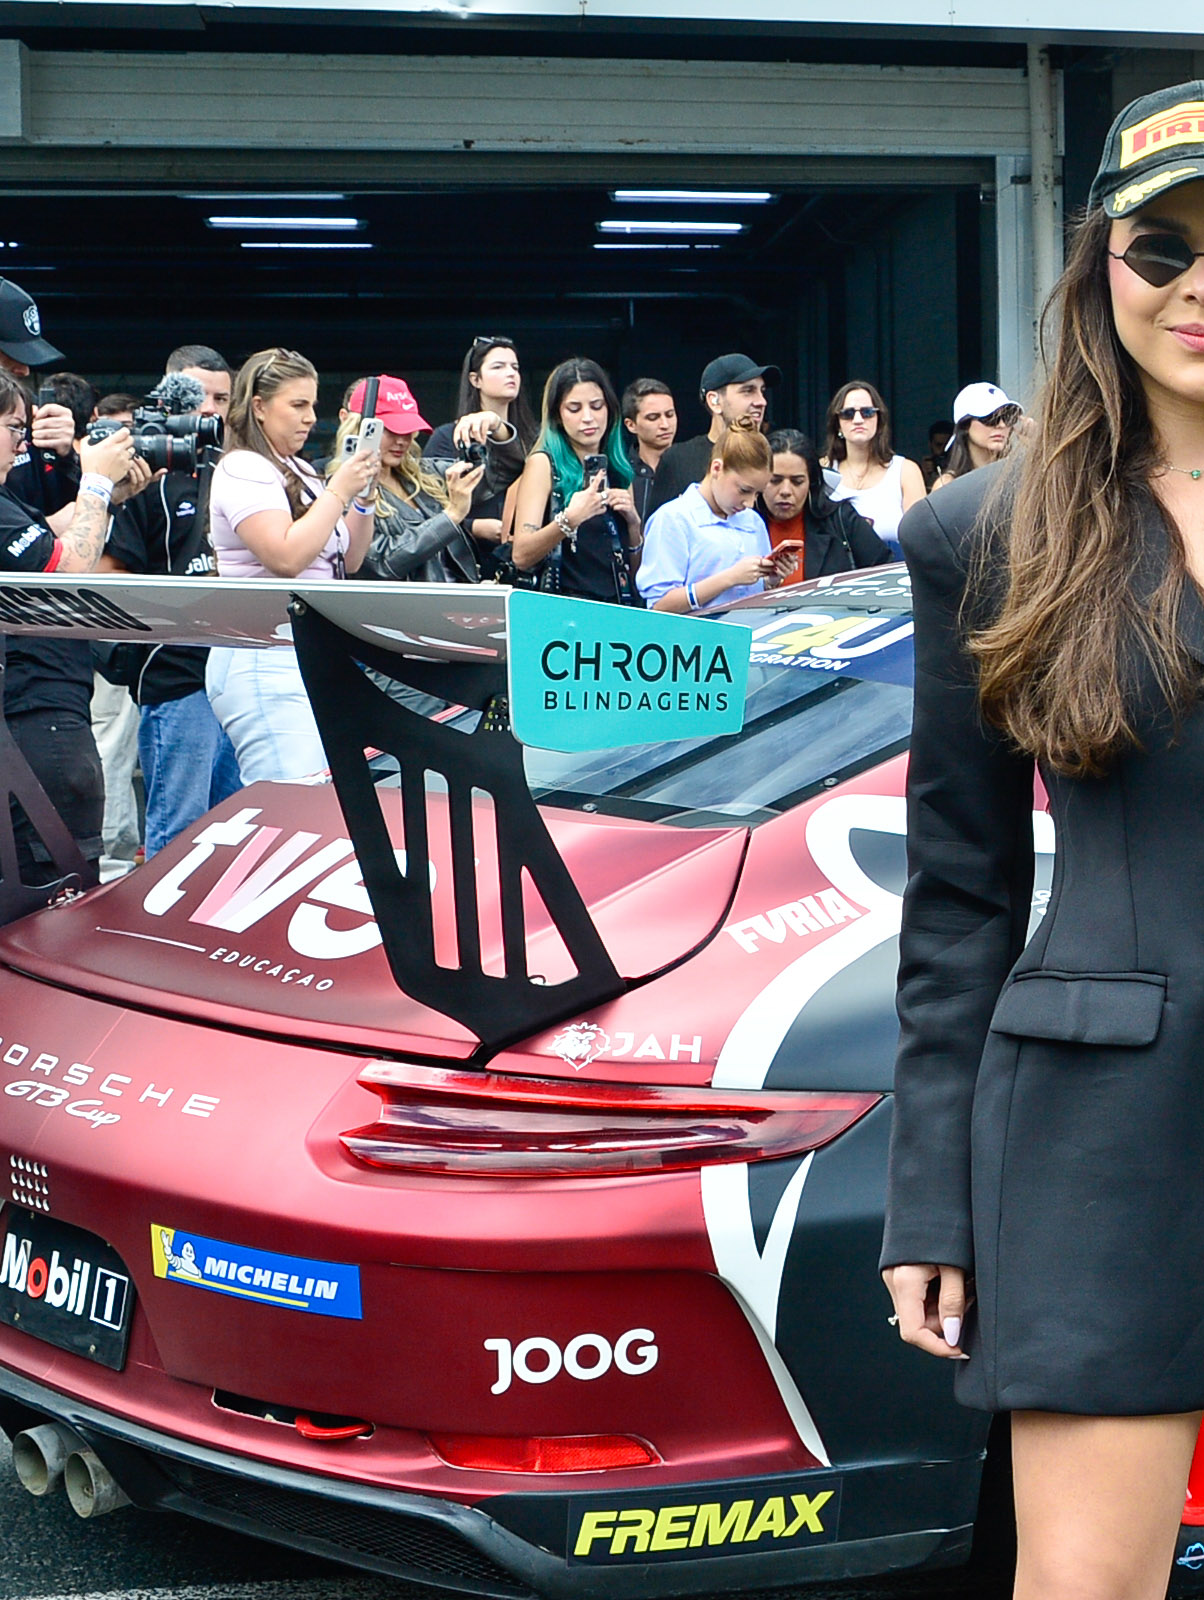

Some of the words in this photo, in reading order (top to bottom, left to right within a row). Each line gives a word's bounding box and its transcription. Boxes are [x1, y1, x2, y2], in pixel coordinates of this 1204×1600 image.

[12, 452, 31, 467] EDIA
[0, 586, 152, 632] ASTRO
[541, 639, 733, 684] CHROMA
[750, 652, 851, 672] GRATION
[543, 691, 729, 711] BLINDAGENS
[611, 1031, 702, 1064] JAH
[0, 1036, 221, 1118] ORSCHE
[4, 1080, 70, 1107] GT3
[65, 1099, 121, 1129] Cup
[0, 1232, 91, 1316] Mobil
[104, 1277, 118, 1321] 1
[203, 1256, 339, 1300] MICHELIN
[483, 1328, 659, 1395] JOOG
[573, 1490, 836, 1556] FREMAX
